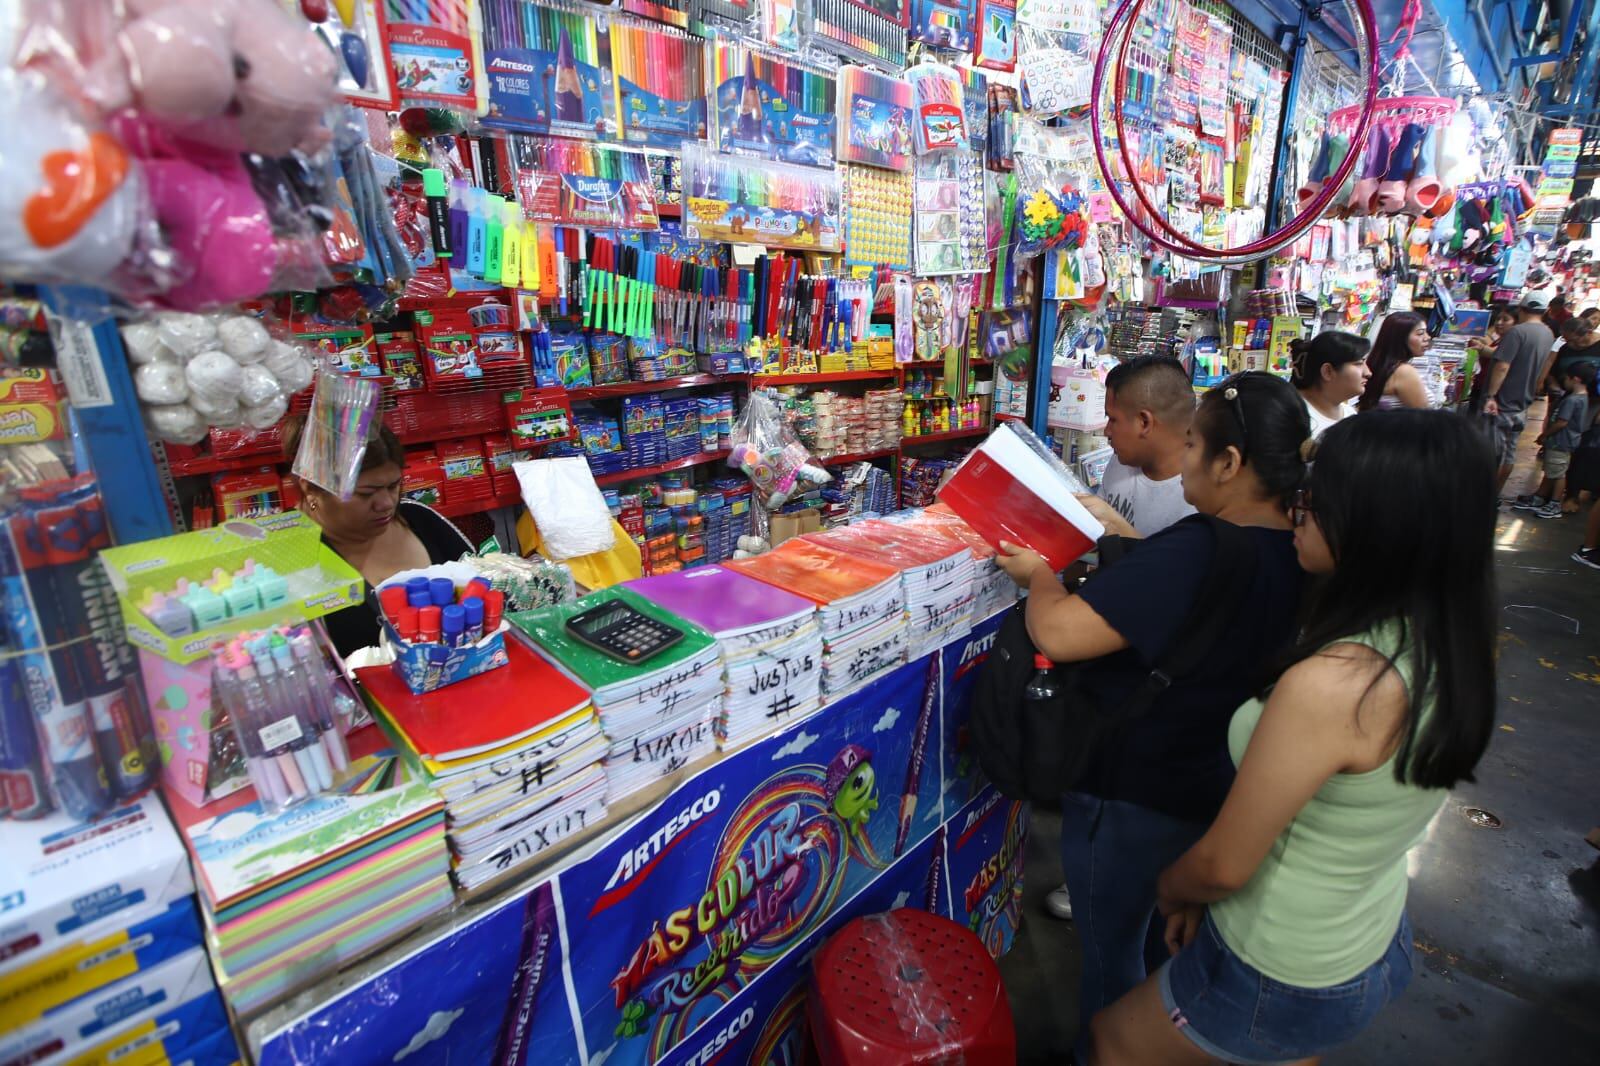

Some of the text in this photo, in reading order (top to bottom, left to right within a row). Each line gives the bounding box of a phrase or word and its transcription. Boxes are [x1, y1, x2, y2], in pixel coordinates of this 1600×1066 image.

[490, 57, 534, 72] ARTESCO
[792, 113, 819, 125] ARTESCO
[537, 403, 560, 412] CASTELL
[77, 565, 122, 681] VINIFAN
[748, 656, 815, 695] JUSTUS
[217, 794, 349, 855] PAPEL COLOR
[604, 788, 720, 892] ARTESCO
[611, 801, 801, 1008] MÁS COLOR
